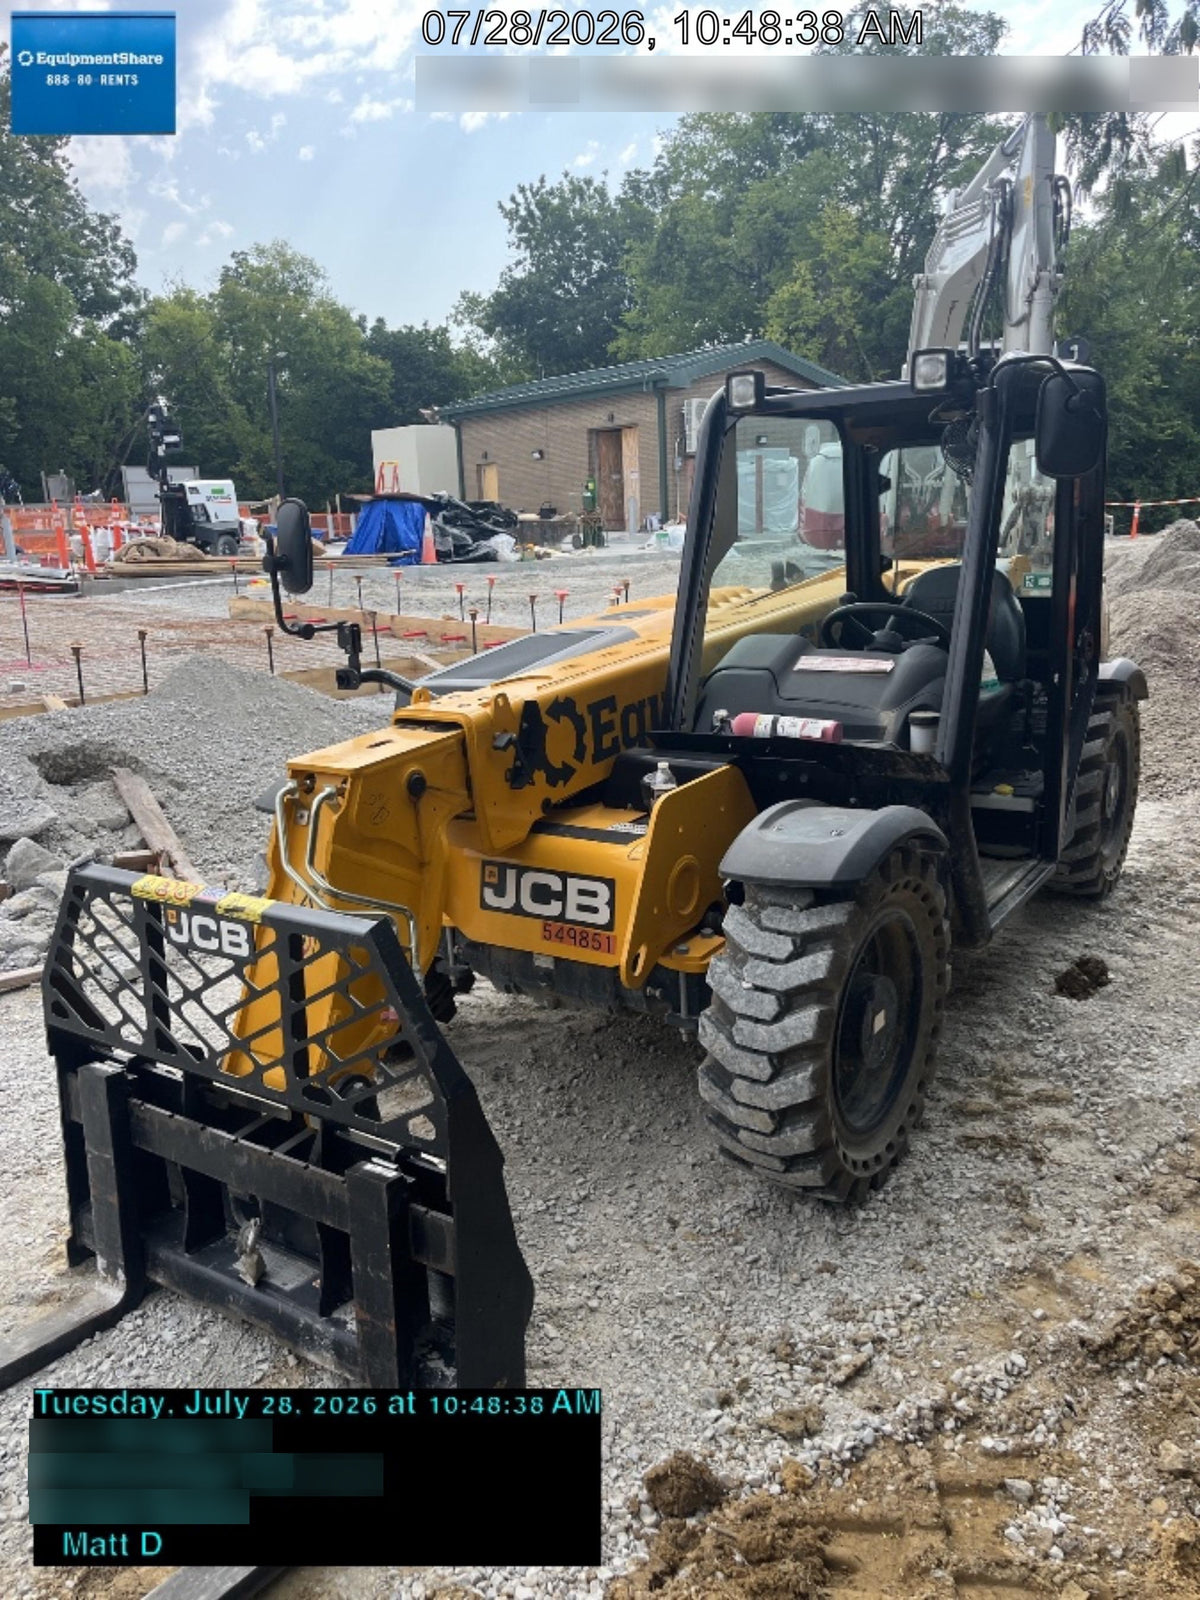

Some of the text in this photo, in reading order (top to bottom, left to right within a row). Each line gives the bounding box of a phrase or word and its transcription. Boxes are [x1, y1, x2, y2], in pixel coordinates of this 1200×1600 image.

[483, 868, 611, 925] JCB
[169, 911, 250, 957] JCB
[543, 922, 613, 954] 549851
